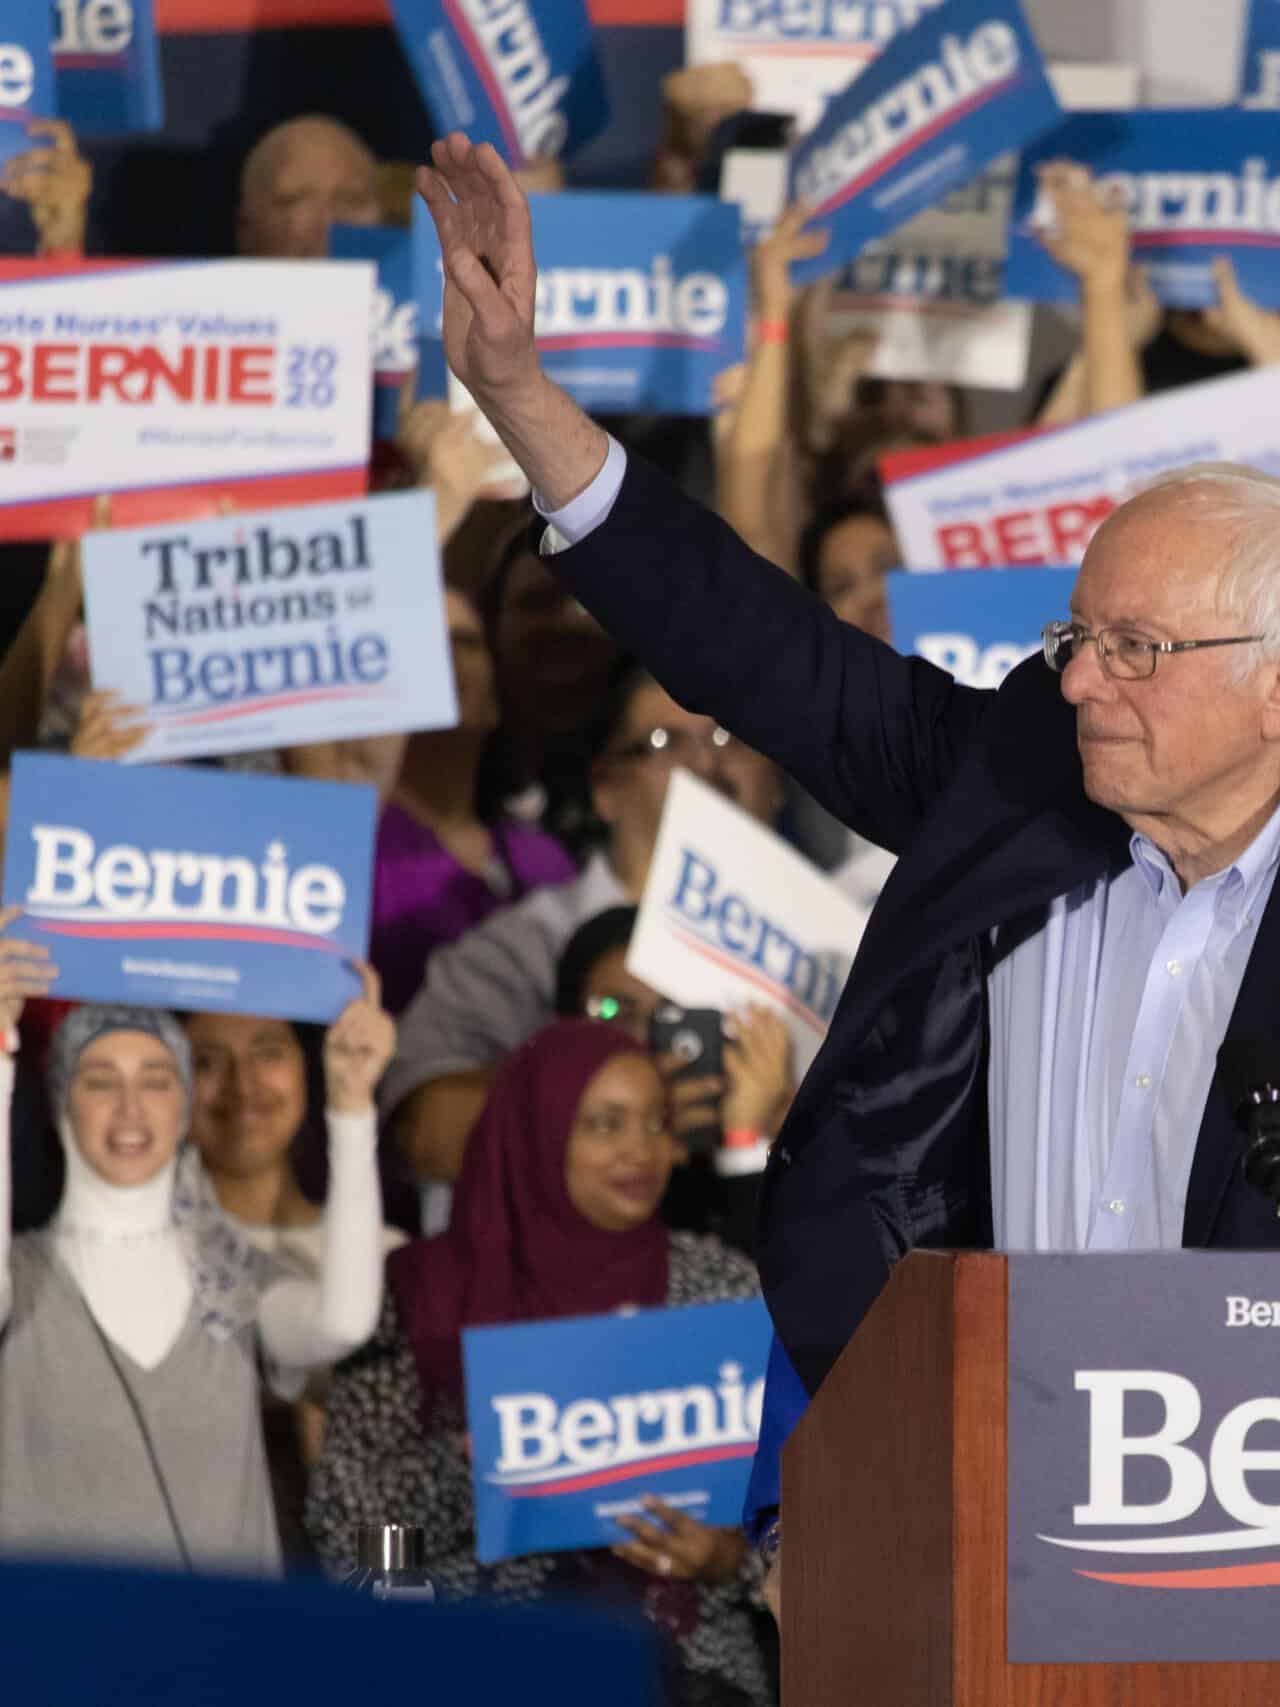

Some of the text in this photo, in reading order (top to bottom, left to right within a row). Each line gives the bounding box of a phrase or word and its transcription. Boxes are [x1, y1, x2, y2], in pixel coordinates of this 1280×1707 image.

[140, 513, 370, 595] Tribal
[143, 582, 337, 640] Nations
[147, 623, 390, 702] Bernie
[26, 824, 348, 936] Bernie
[672, 843, 840, 1022] Berni
